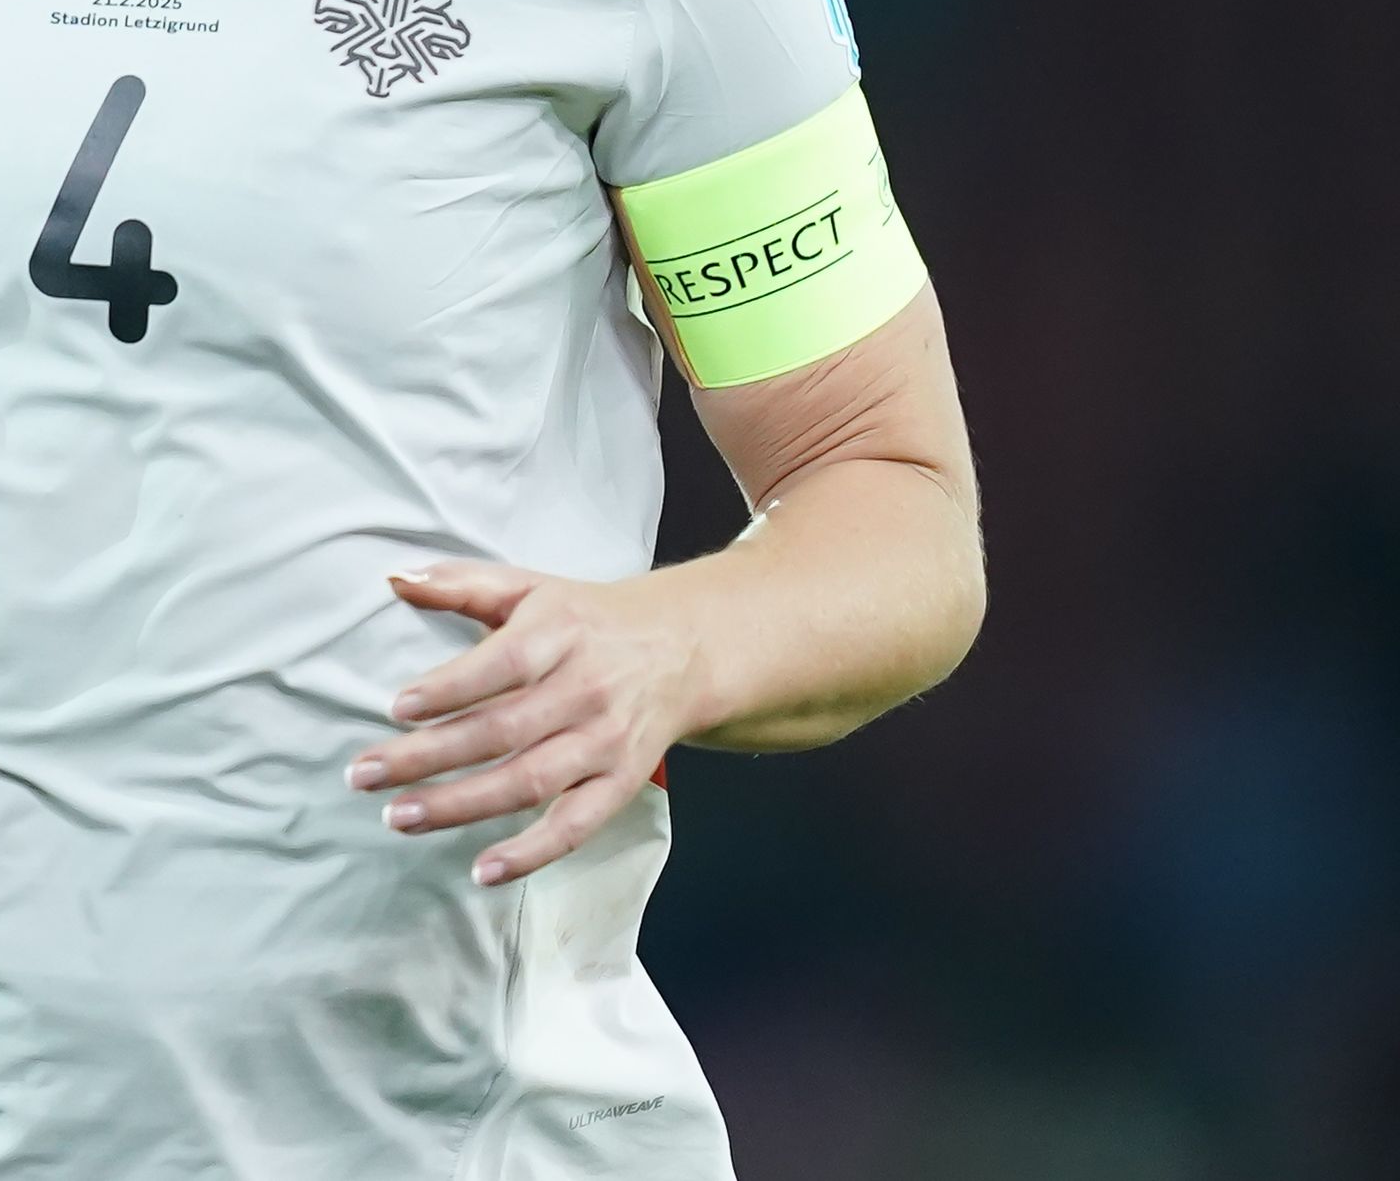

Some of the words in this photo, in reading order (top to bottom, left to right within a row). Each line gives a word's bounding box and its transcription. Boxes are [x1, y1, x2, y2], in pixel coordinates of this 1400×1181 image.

[50, 12, 118, 28] Stadion
[124, 15, 220, 34] Letzigrund
[29, 75, 178, 343] 4
[654, 206, 842, 305] RESPECT
[568, 1095, 665, 1131] ULTRAWEAVE
